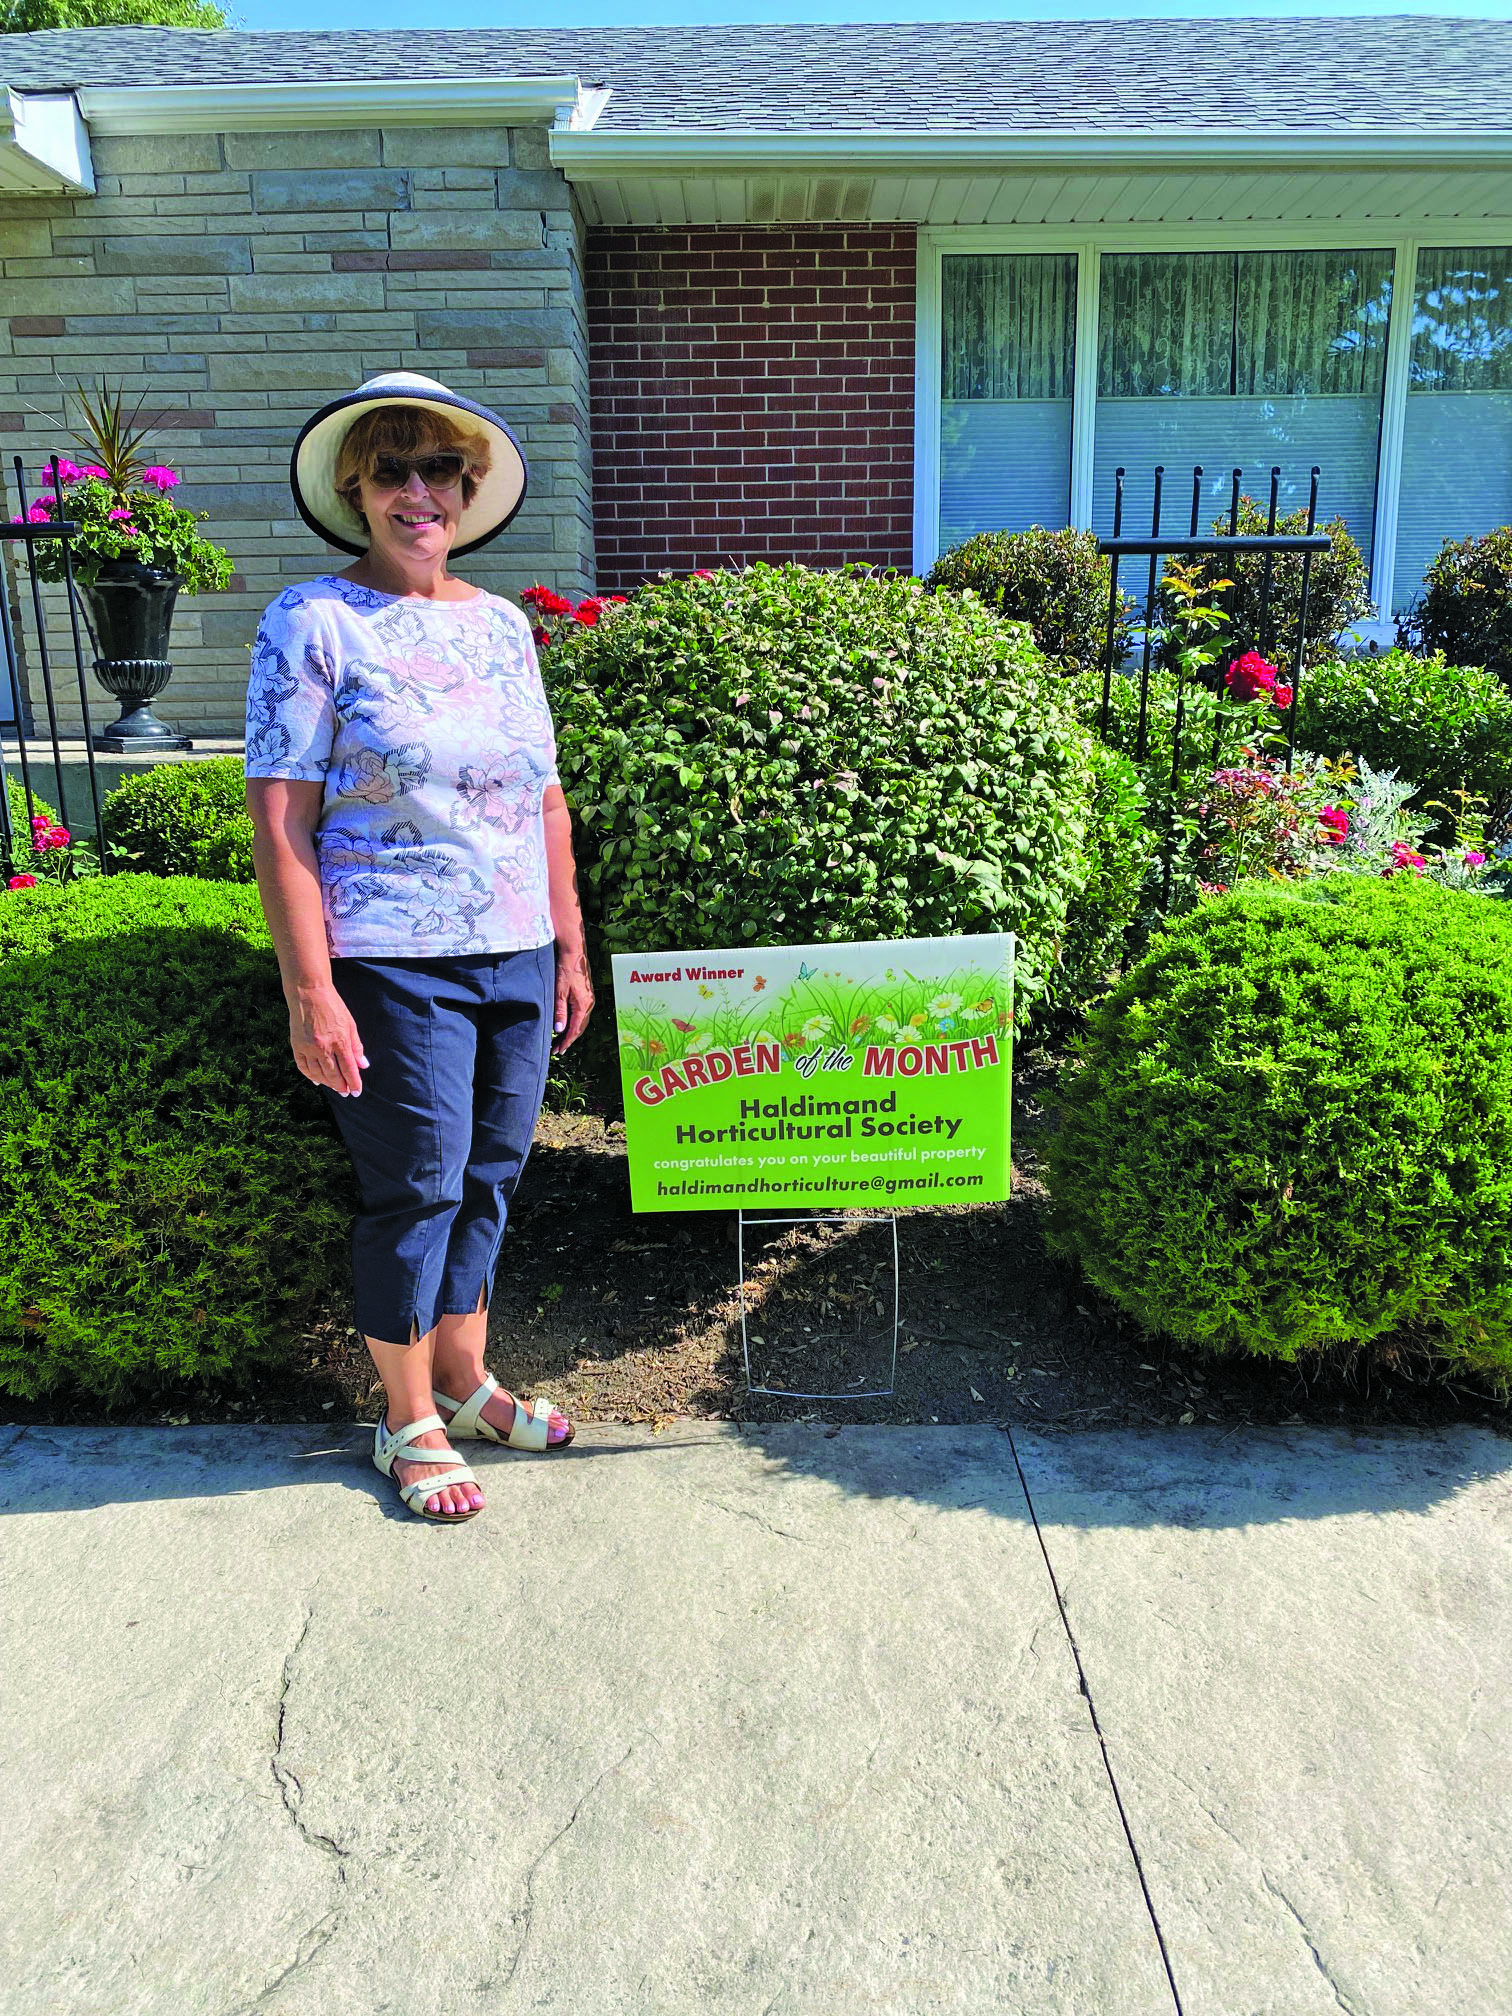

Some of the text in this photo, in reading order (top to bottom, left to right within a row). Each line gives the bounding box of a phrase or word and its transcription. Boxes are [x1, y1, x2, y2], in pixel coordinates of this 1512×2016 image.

[630, 967, 744, 984] Award Winner
[634, 1034, 999, 1106] GARDEN of the MONTH
[740, 1091, 896, 1119] Haldimand
[677, 1113, 962, 1144] Horticultural Society
[654, 1146, 986, 1171] congratulates you on your beautiful property
[657, 1173, 983, 1198] haldimandhorticulture@gmail.com
